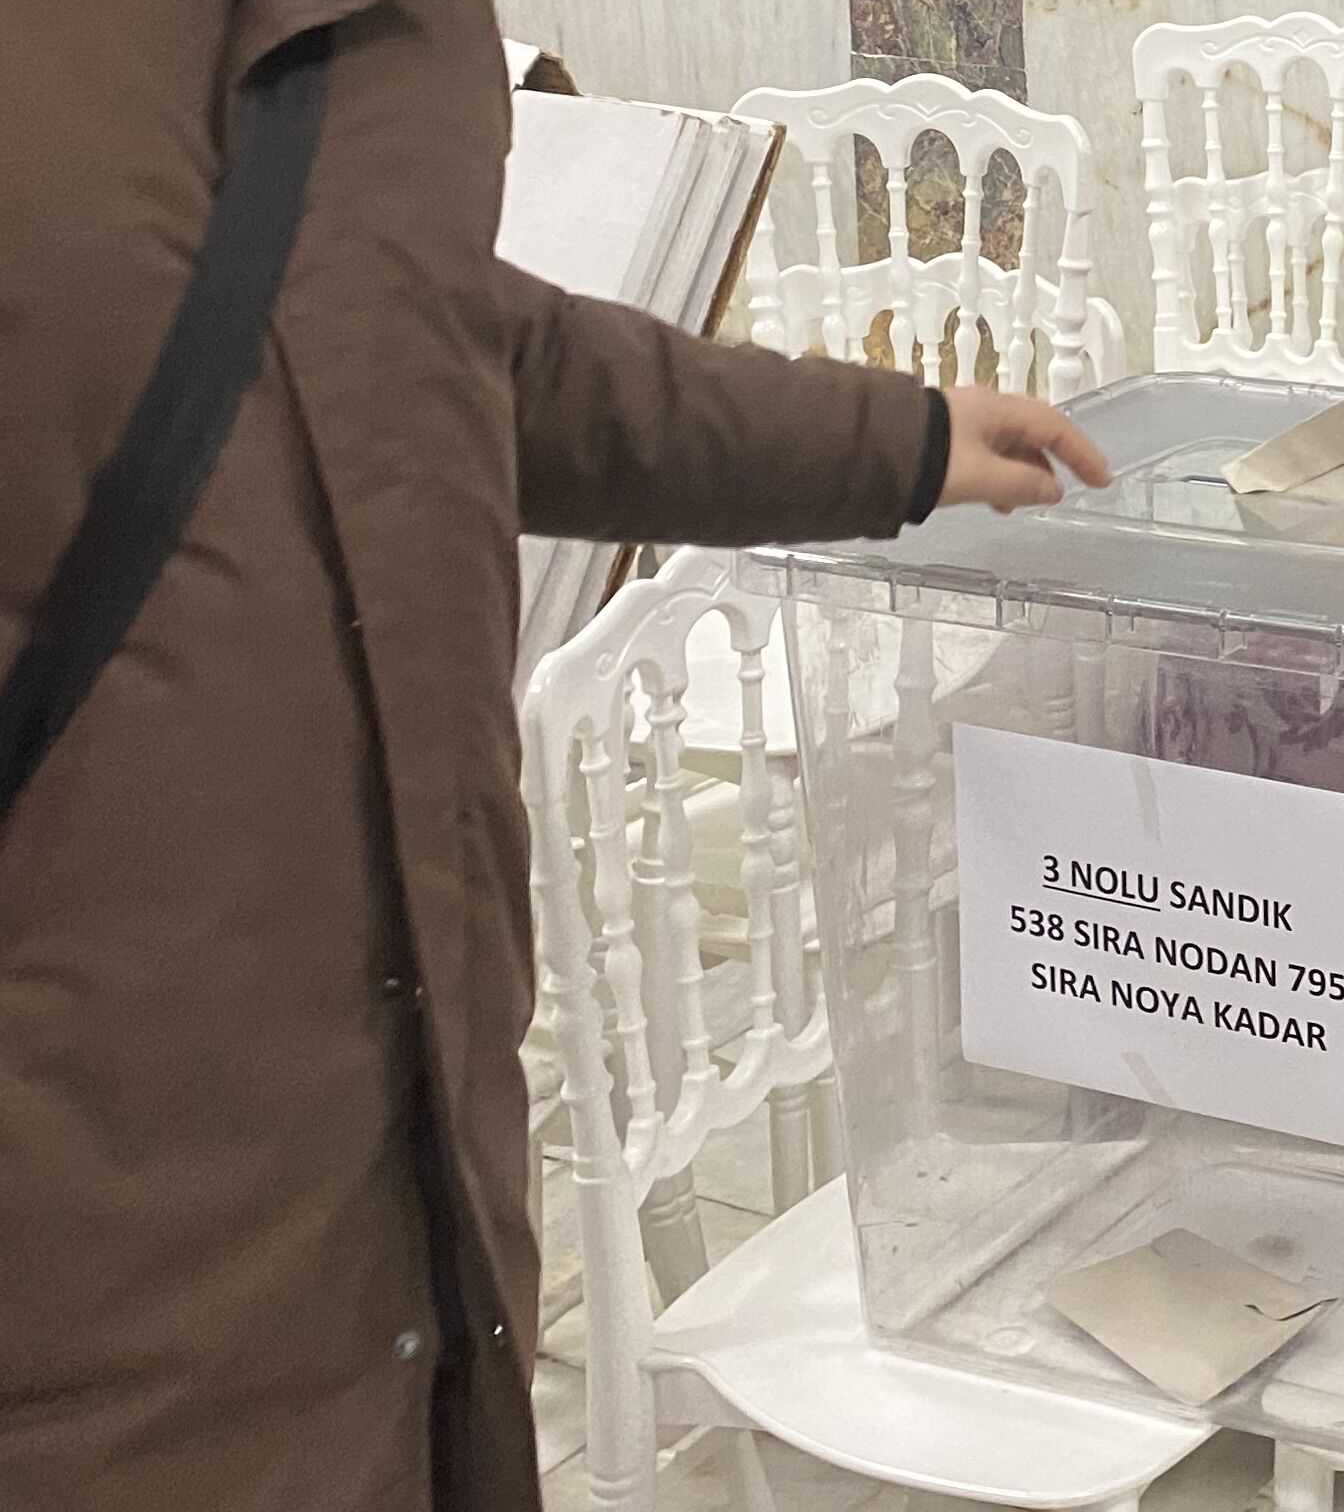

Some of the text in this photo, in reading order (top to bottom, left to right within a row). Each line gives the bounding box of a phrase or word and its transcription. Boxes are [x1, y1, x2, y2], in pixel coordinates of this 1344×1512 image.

[1043, 855, 1293, 932] 3 NOLU SANDIK
[1010, 905, 1065, 941] 538
[1074, 919, 1145, 960] SIRA
[1155, 936, 1277, 987] NODAN
[1031, 962, 1327, 1052] SIRA NOYA KADAR
